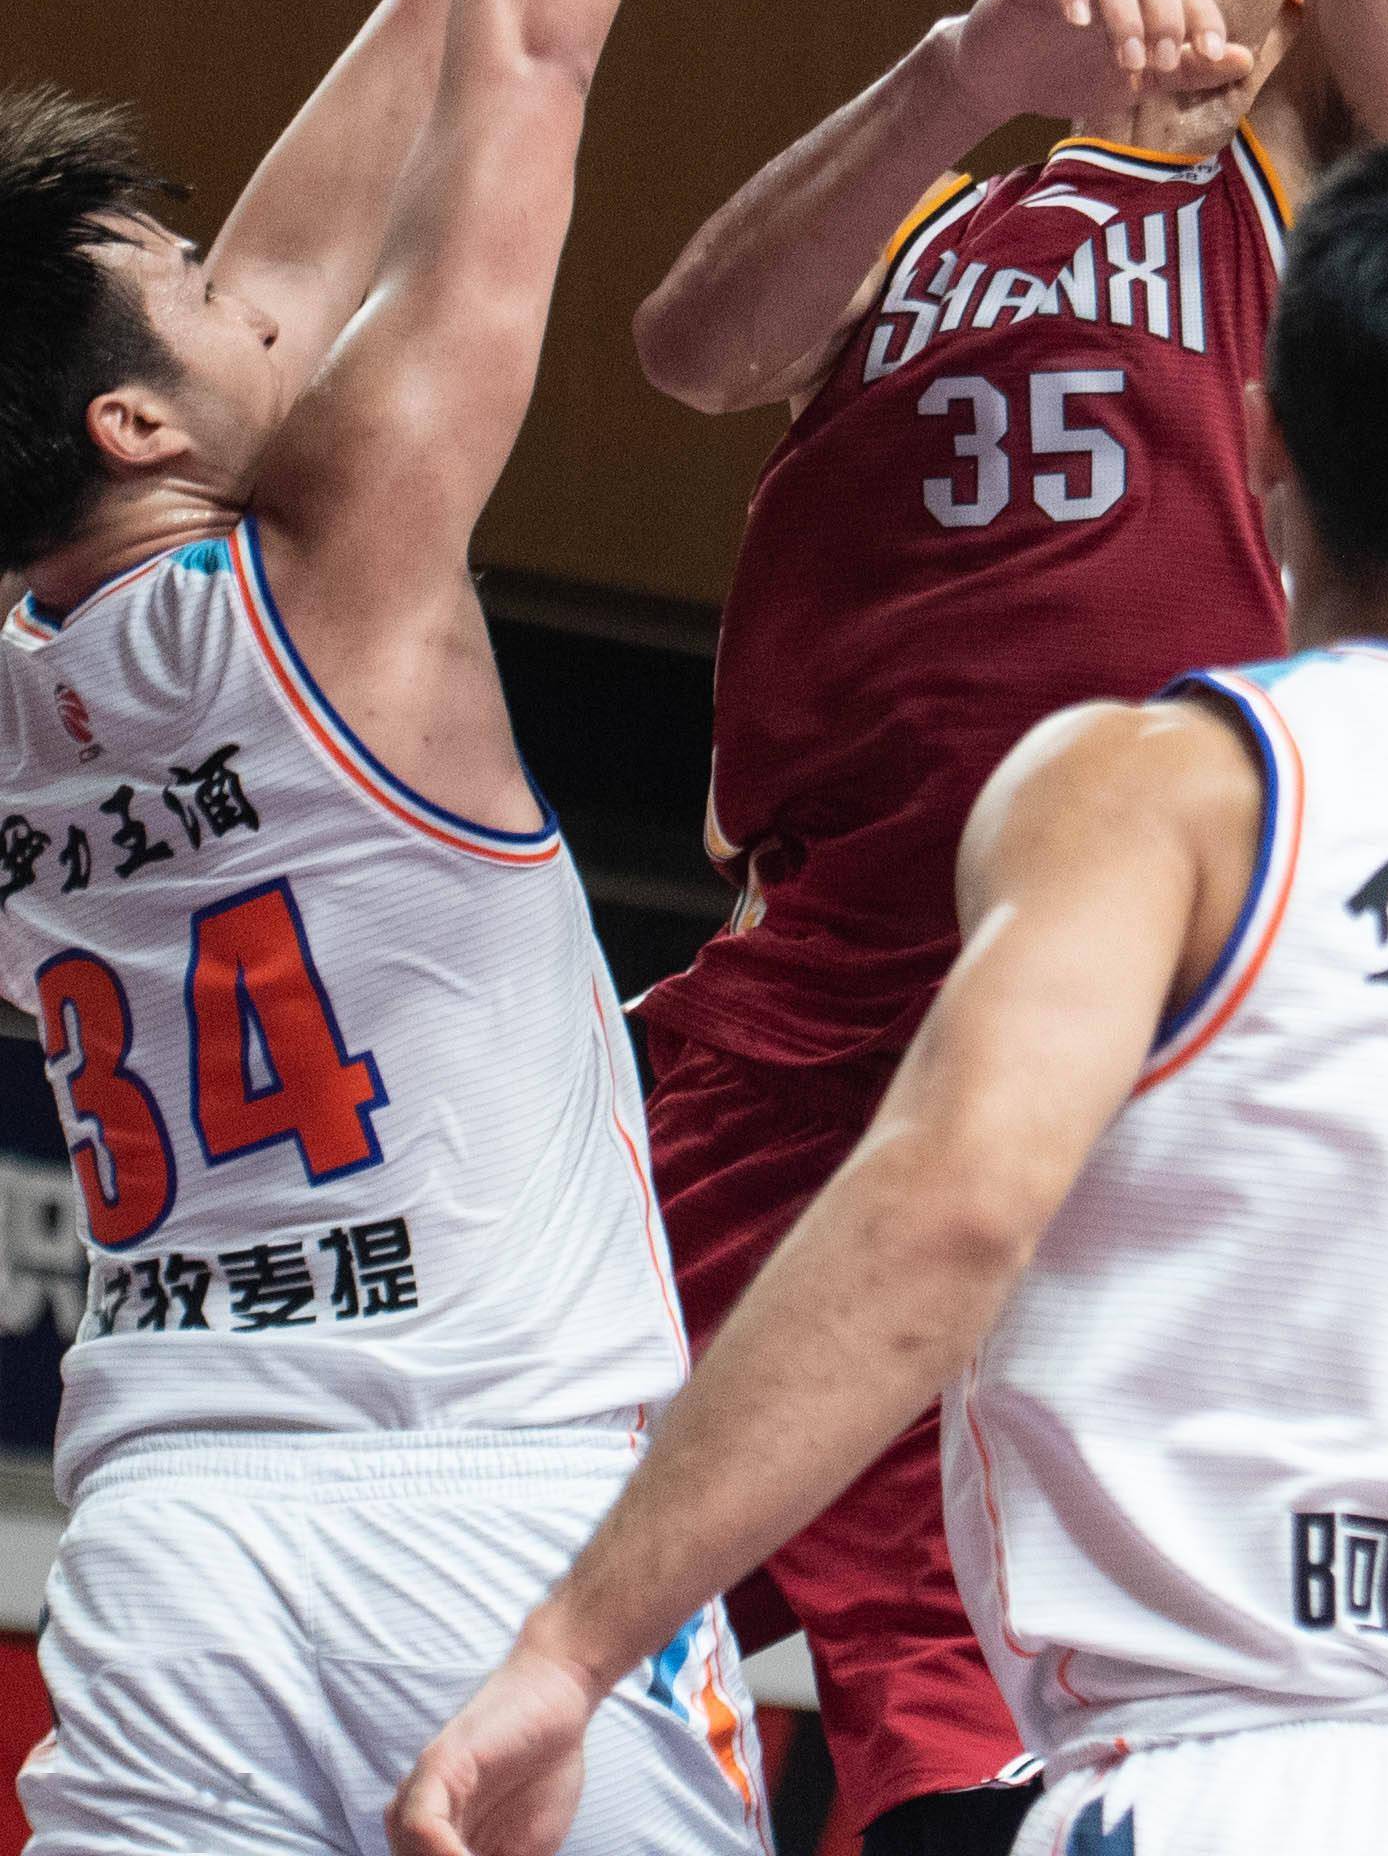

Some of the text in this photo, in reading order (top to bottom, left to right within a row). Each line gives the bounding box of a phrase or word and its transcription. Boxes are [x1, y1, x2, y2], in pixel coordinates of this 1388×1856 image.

[863, 194, 1207, 384] SHANXI
[917, 369, 1127, 528] 35
[35, 876, 390, 1253] 34
